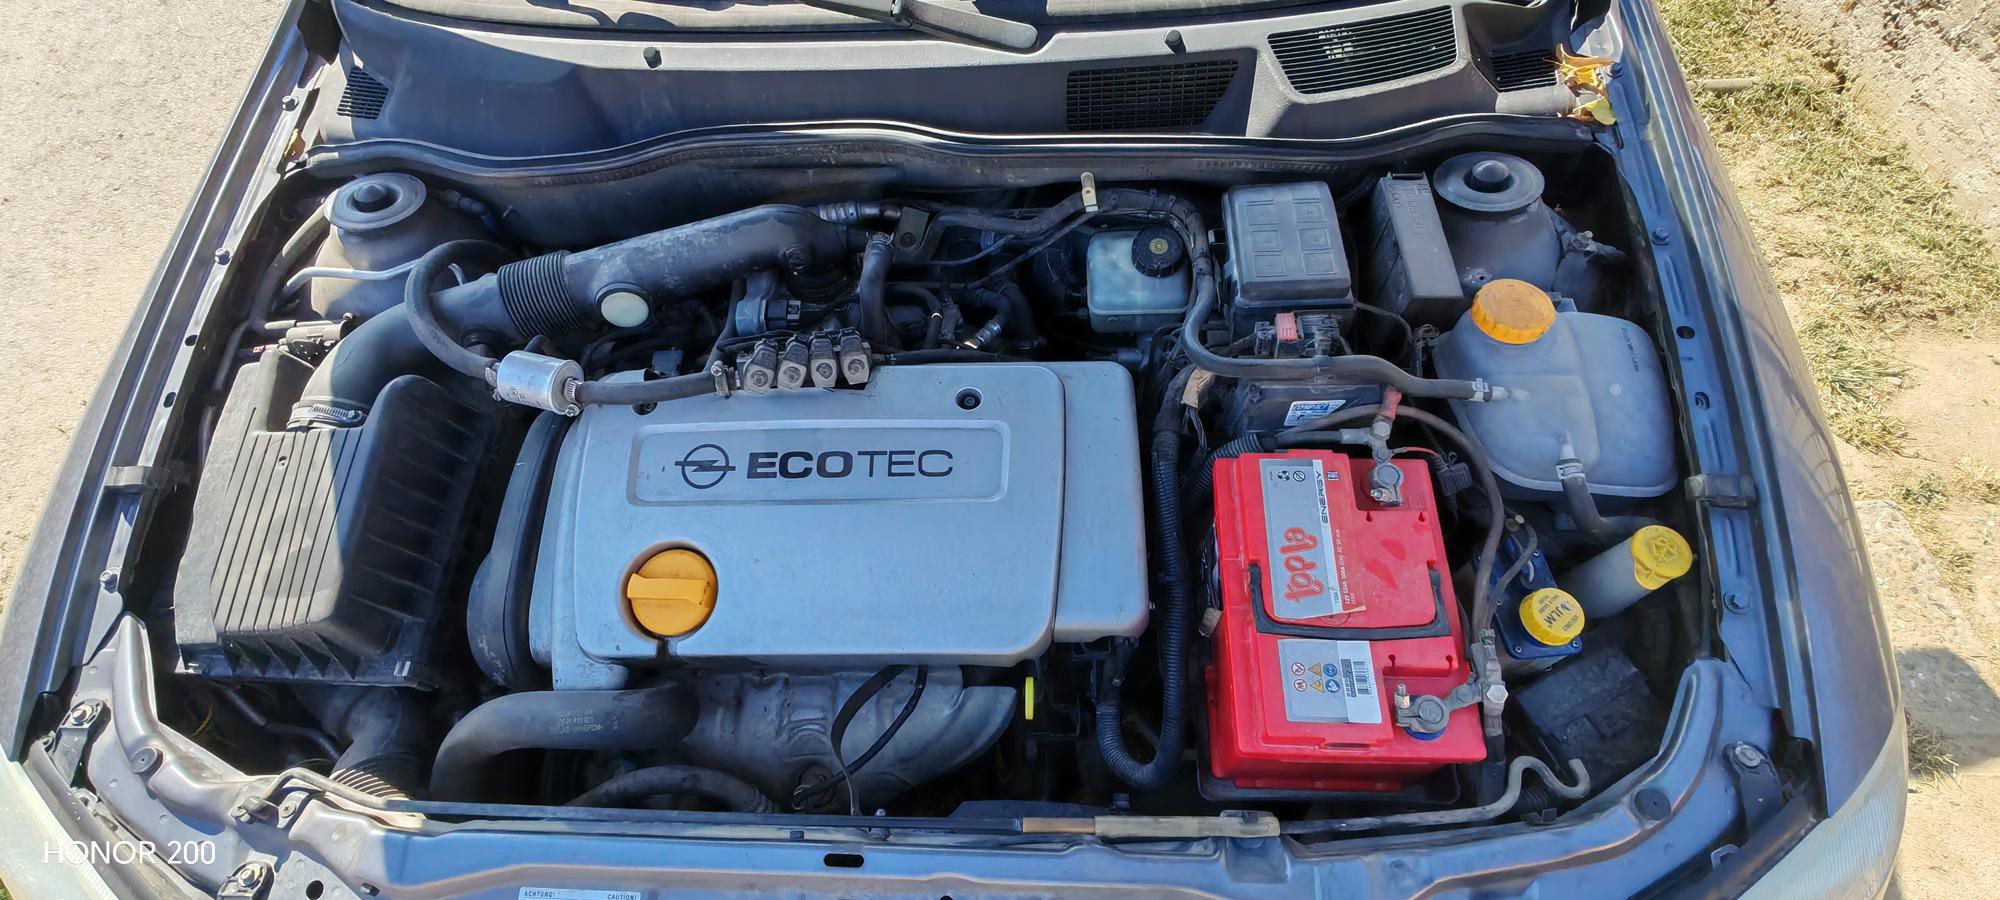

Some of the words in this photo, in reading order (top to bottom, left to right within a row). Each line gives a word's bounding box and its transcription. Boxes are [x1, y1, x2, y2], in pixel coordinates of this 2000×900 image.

[746, 449, 954, 479] ECOTEC
[1315, 471, 1328, 524] ENERGY
[1544, 606, 1564, 625] JLM
[524, 890, 555, 898] ACHTUNG!
